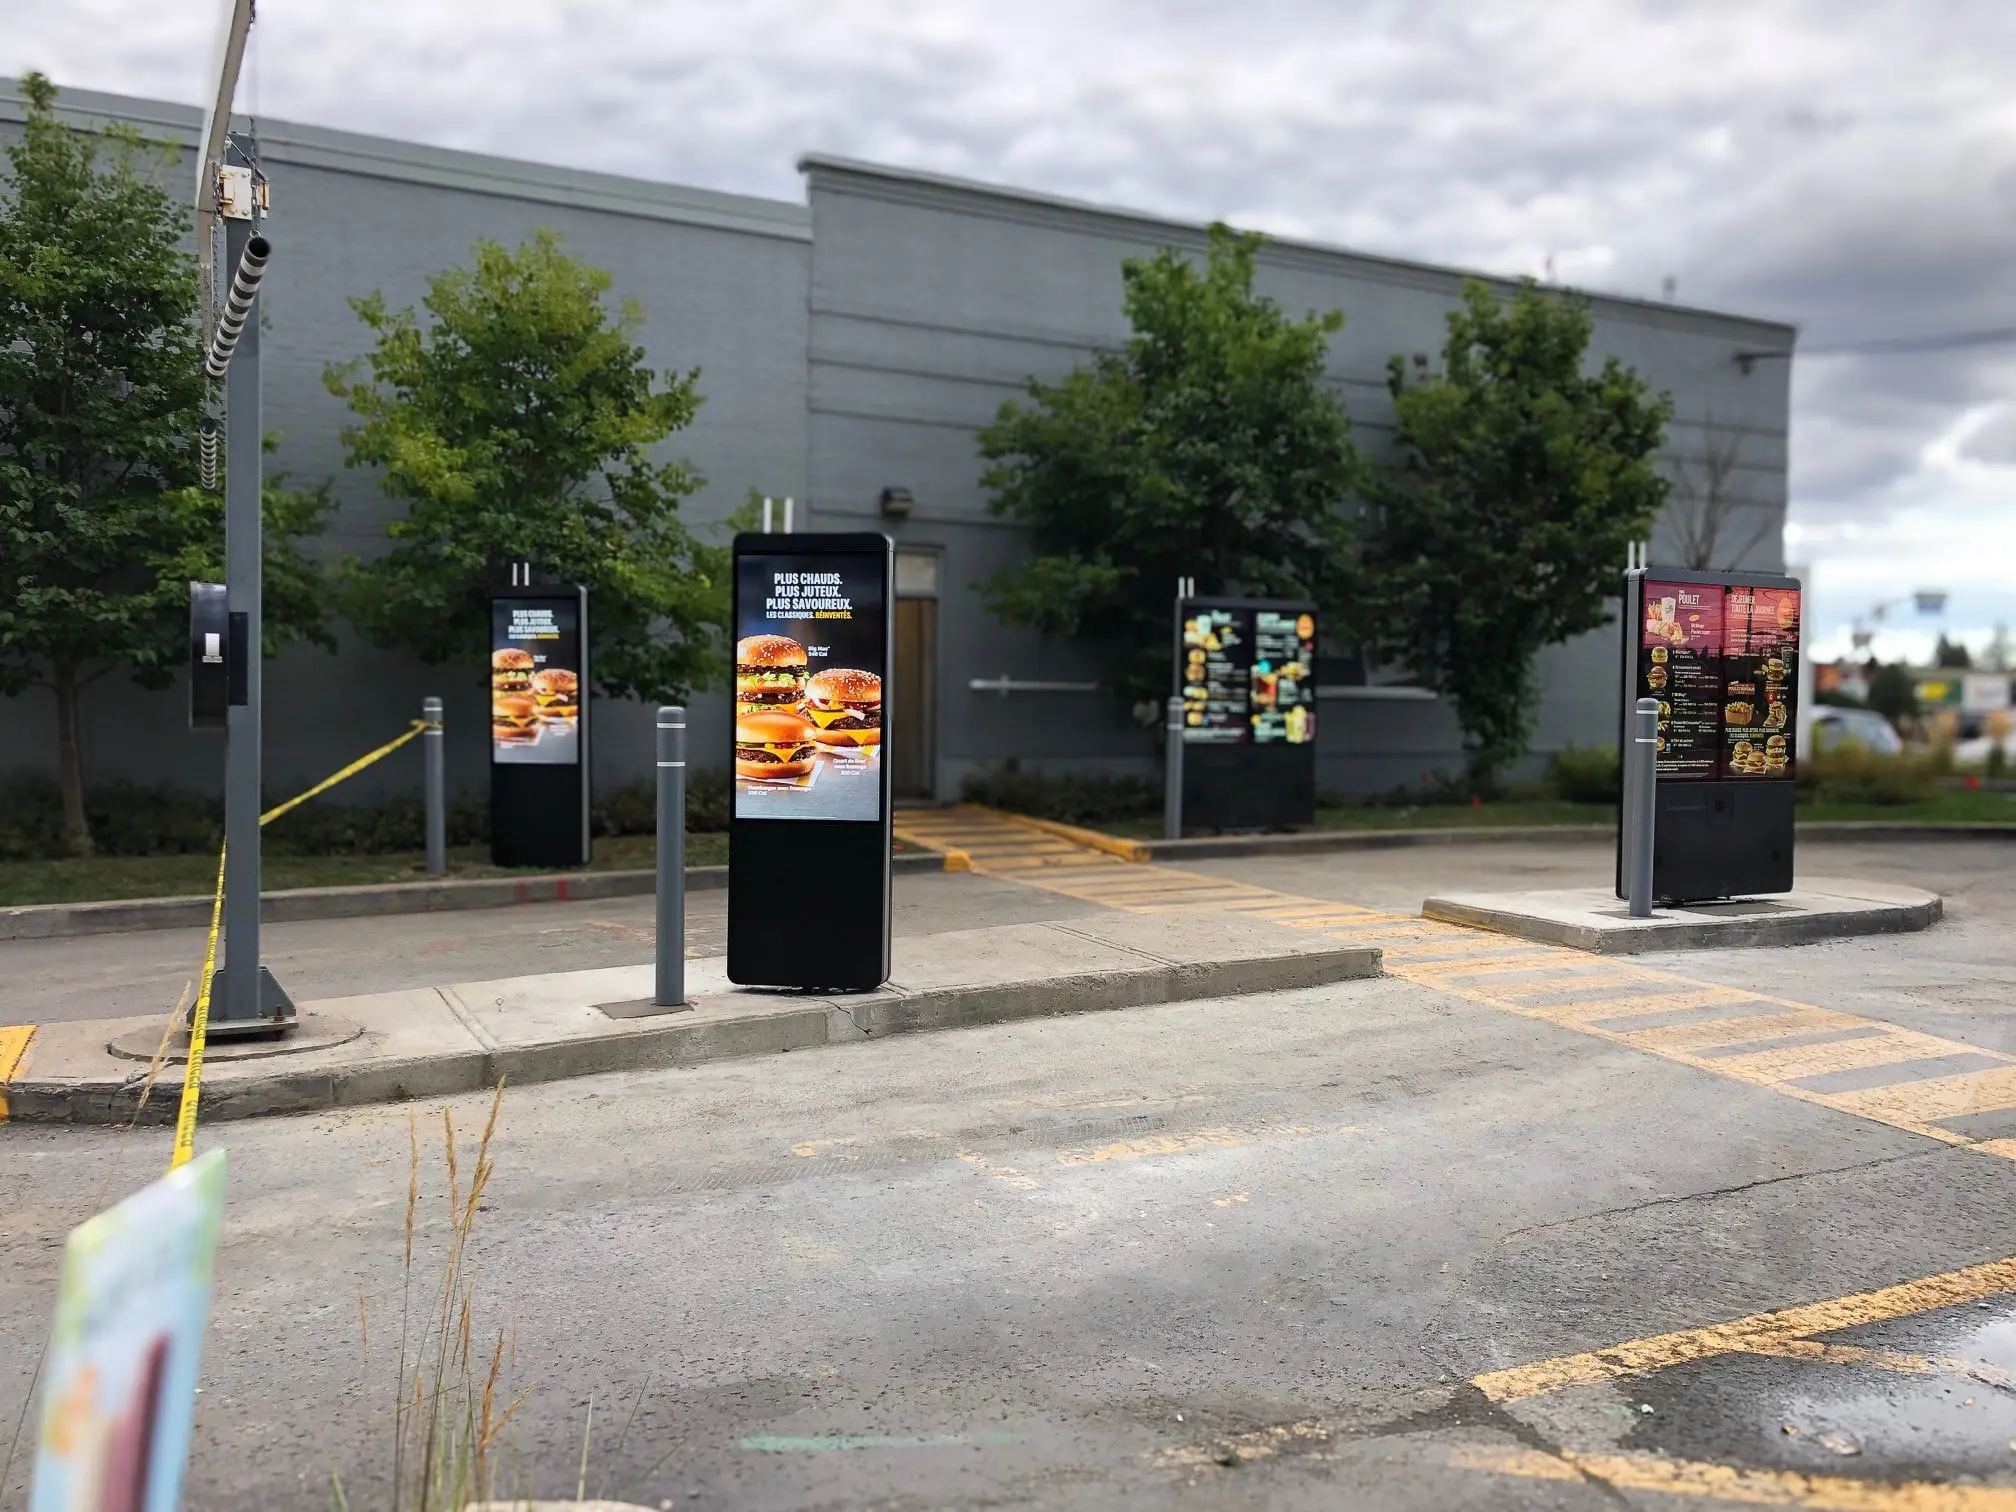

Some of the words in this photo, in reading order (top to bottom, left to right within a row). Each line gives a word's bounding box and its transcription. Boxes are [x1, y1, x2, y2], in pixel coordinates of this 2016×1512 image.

[774, 573, 799, 585] PLUS
[800, 573, 843, 585] CHAUDS.
[775, 585, 800, 597] PLUS
[801, 586, 842, 597] JUTEUX.
[766, 598, 791, 610] PLUS
[792, 598, 853, 610] SAVOUREUX.
[1679, 594, 1700, 606] POULET
[766, 611, 777, 619] LES
[777, 611, 814, 620] CLASSIQUES.
